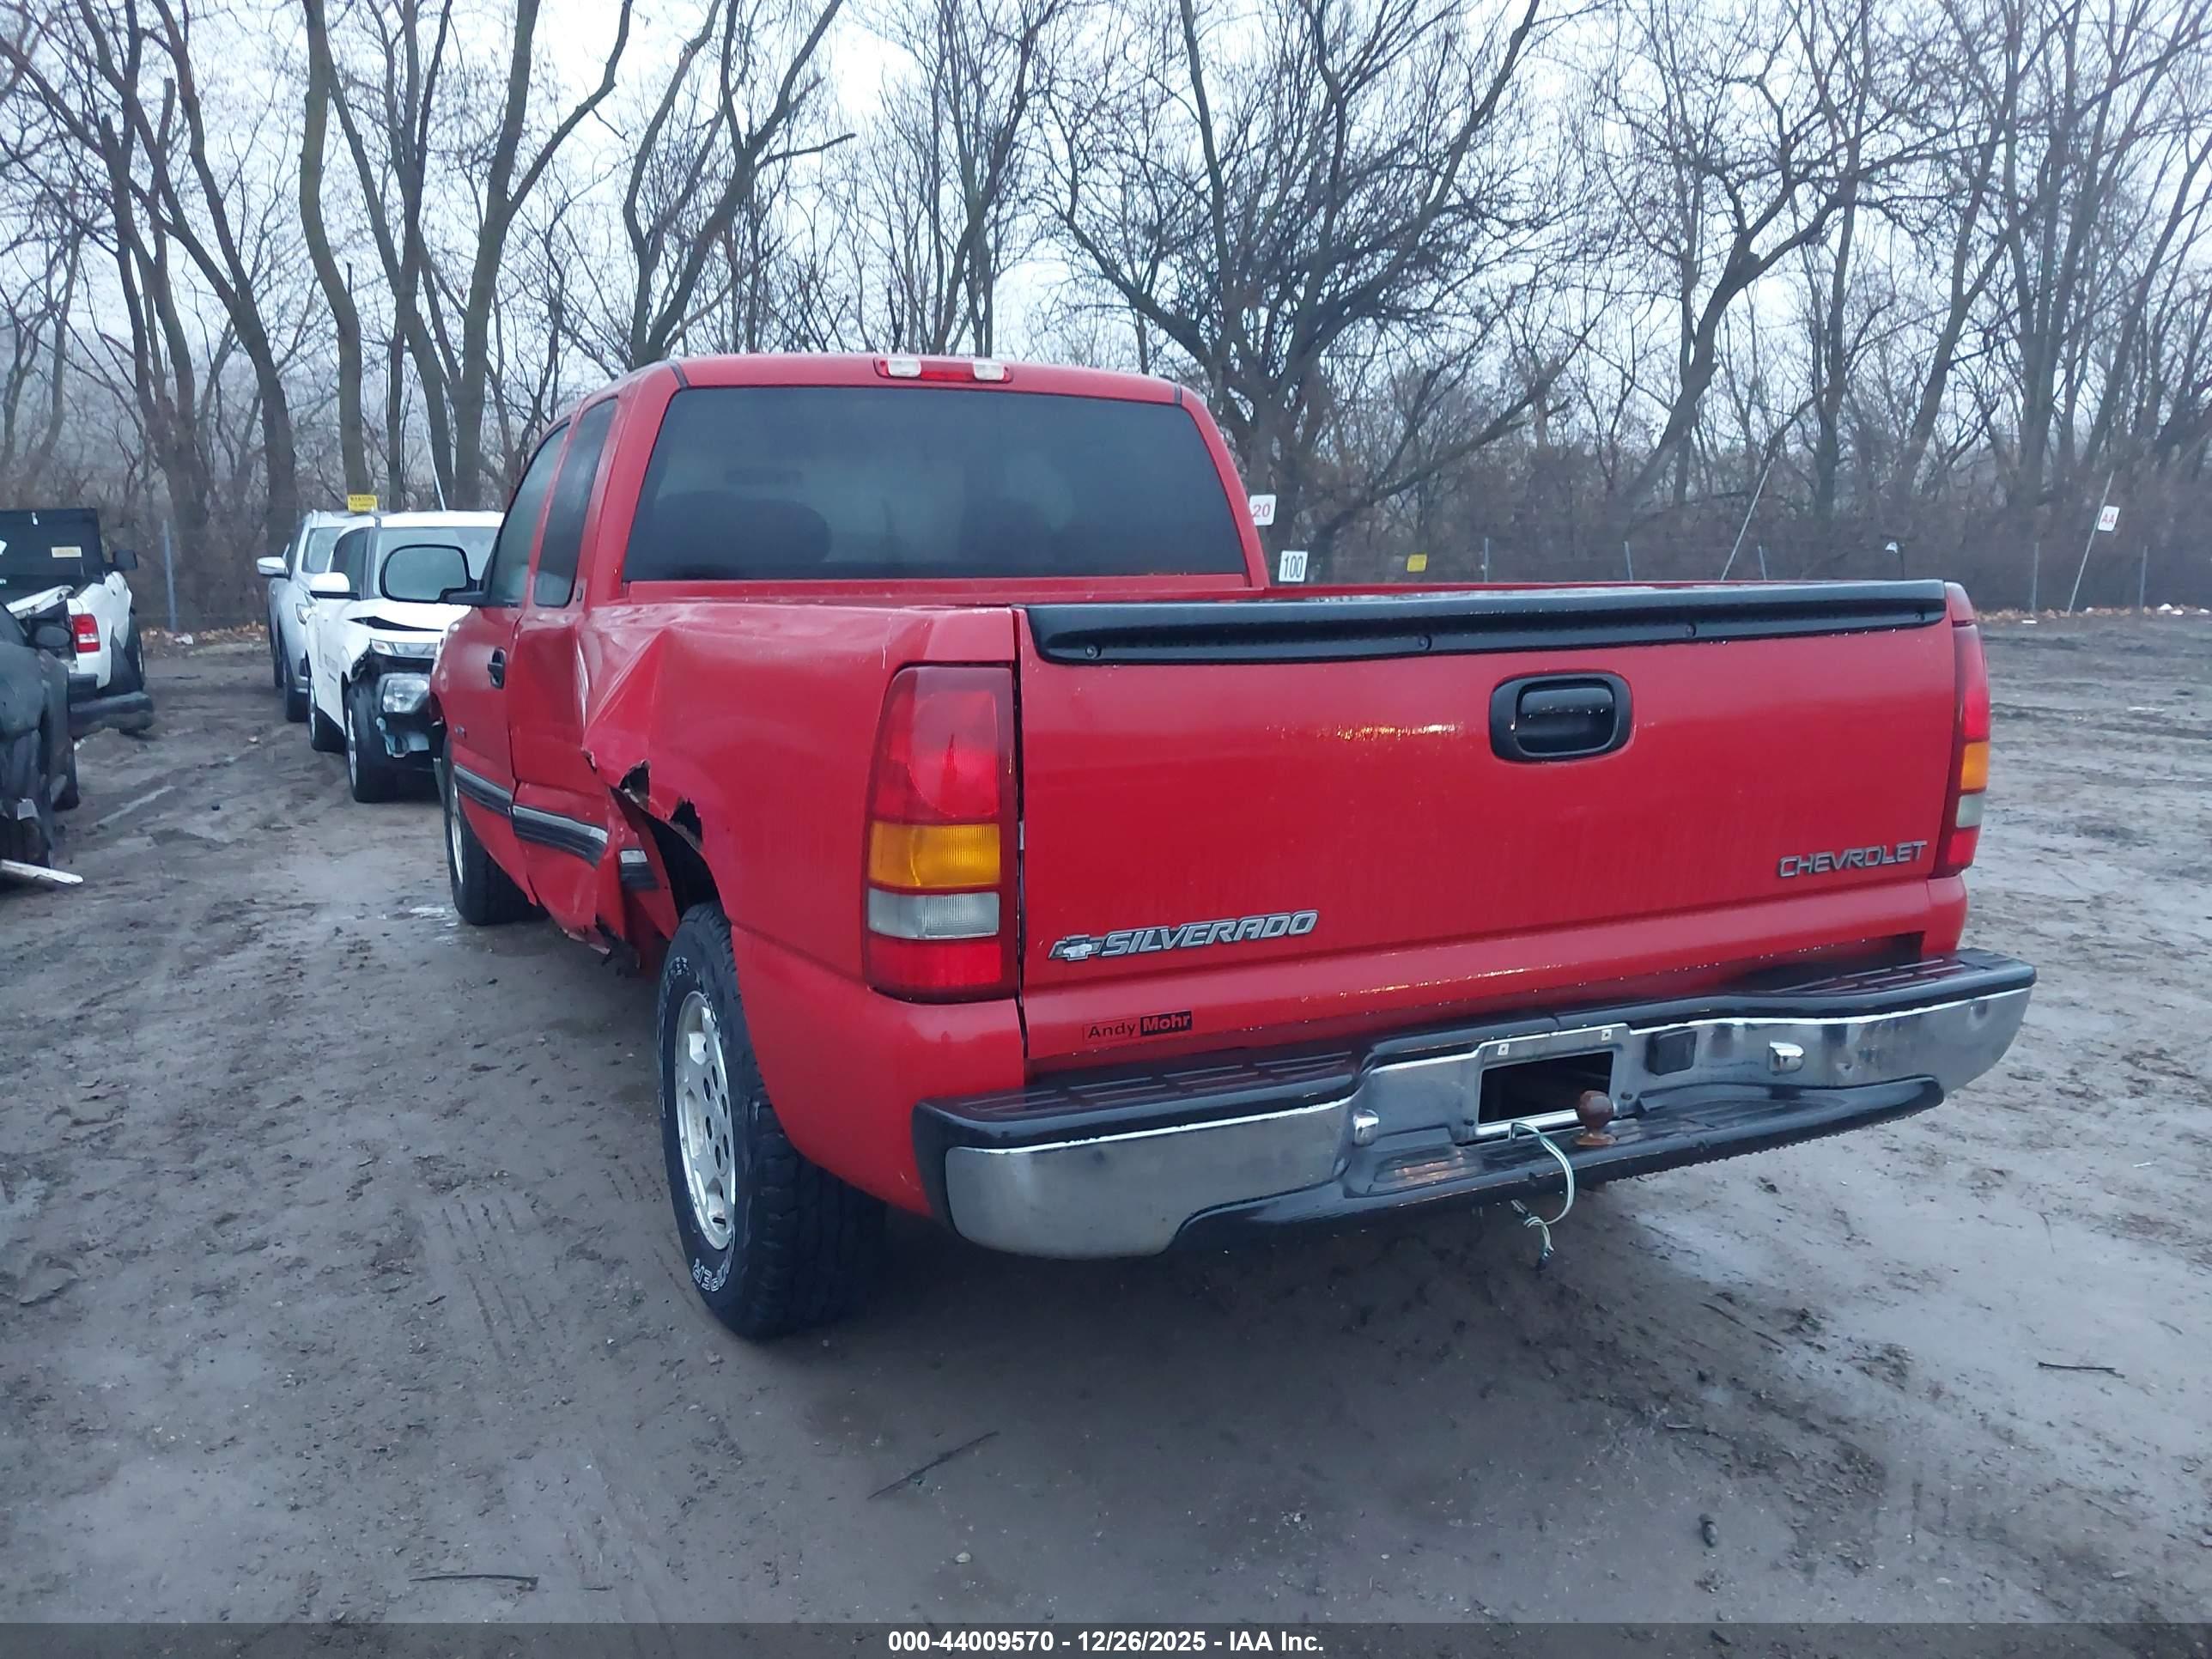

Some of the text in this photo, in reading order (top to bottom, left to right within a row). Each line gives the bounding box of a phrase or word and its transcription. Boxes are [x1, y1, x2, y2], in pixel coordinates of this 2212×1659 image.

[1284, 555, 1304, 579] 100
[1778, 840, 1927, 878] CHEVROLET
[1099, 909, 1319, 957] SILVERADO
[1088, 1014, 1190, 1039] Andy Mohr
